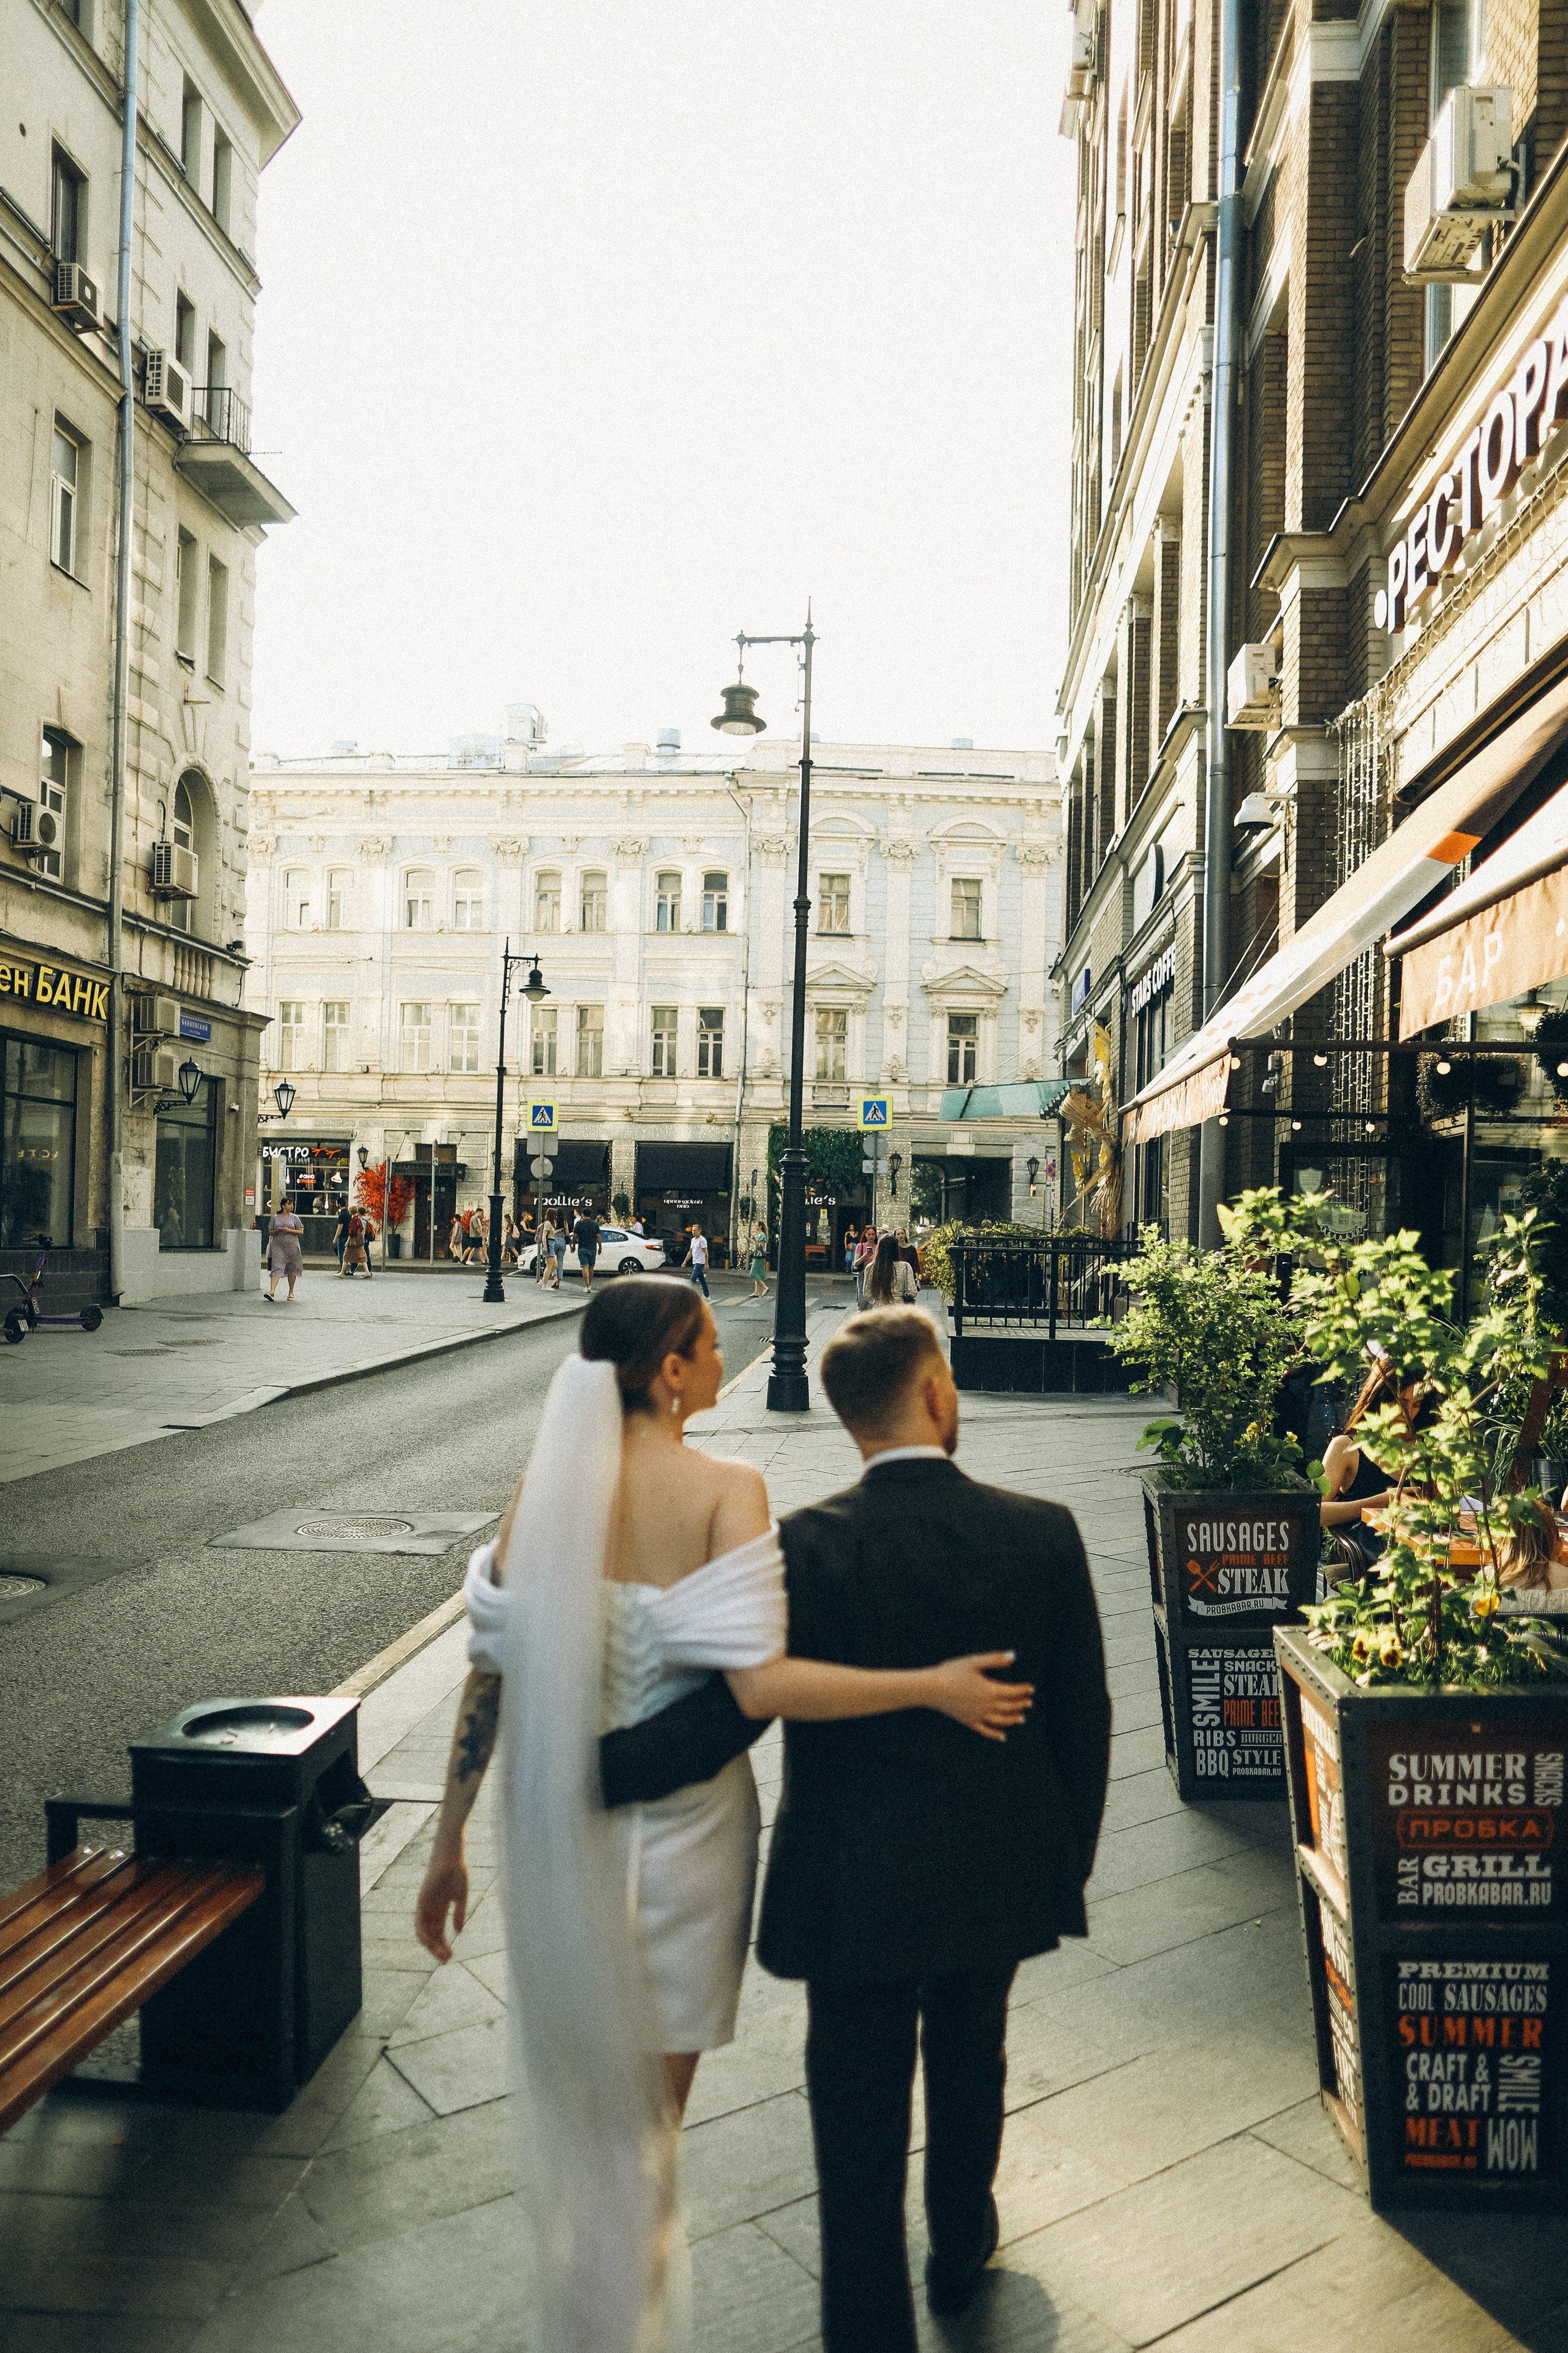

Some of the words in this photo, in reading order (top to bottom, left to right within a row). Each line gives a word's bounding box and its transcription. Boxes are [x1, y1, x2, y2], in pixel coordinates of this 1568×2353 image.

[1434, 931, 1503, 1008] БАР
[36, 965, 110, 1020] БАНК
[1132, 969, 1152, 1019] STARS
[262, 1146, 309, 1158] БИСТРО
[1187, 1522, 1289, 1552] SAUSAGES
[1218, 1568, 1290, 1594] STEAK
[1206, 1600, 1264, 1615] PROBKABAR.RU
[1191, 1660, 1220, 1726] SMILE
[1224, 1699, 1256, 1727] PRIME
[1194, 1730, 1236, 1747] RIBS
[1240, 1733, 1282, 1743] BURGER
[1196, 1749, 1229, 1778] BBQ
[1232, 1749, 1281, 1766] STYLE
[1232, 1767, 1281, 1776] PROBKABAR.RU
[1388, 1753, 1526, 1781] SUMMER
[1388, 1783, 1526, 1805] DRINKS
[1534, 1753, 1564, 1806] SNACKS
[1410, 1819, 1540, 1838] ПРОБКА
[1398, 1856, 1419, 1905] BAR
[1423, 1856, 1551, 1878] GRILL
[1423, 1882, 1551, 1906] PROBKABAR.RU
[1398, 1962, 1550, 1980] PREMIUM
[1399, 1983, 1434, 2011] COOL
[1444, 1982, 1547, 2012] SAUSAGES
[1398, 2015, 1543, 2048] SUMMER
[1406, 2052, 1468, 2081] CRAFT
[1476, 2053, 1489, 2083] &
[1406, 2082, 1419, 2111] &
[1428, 2083, 1491, 2112] DRAFT
[1498, 2055, 1541, 2113] SMILE
[1406, 2118, 1481, 2147] MEAT
[1488, 2118, 1537, 2170] WOW
